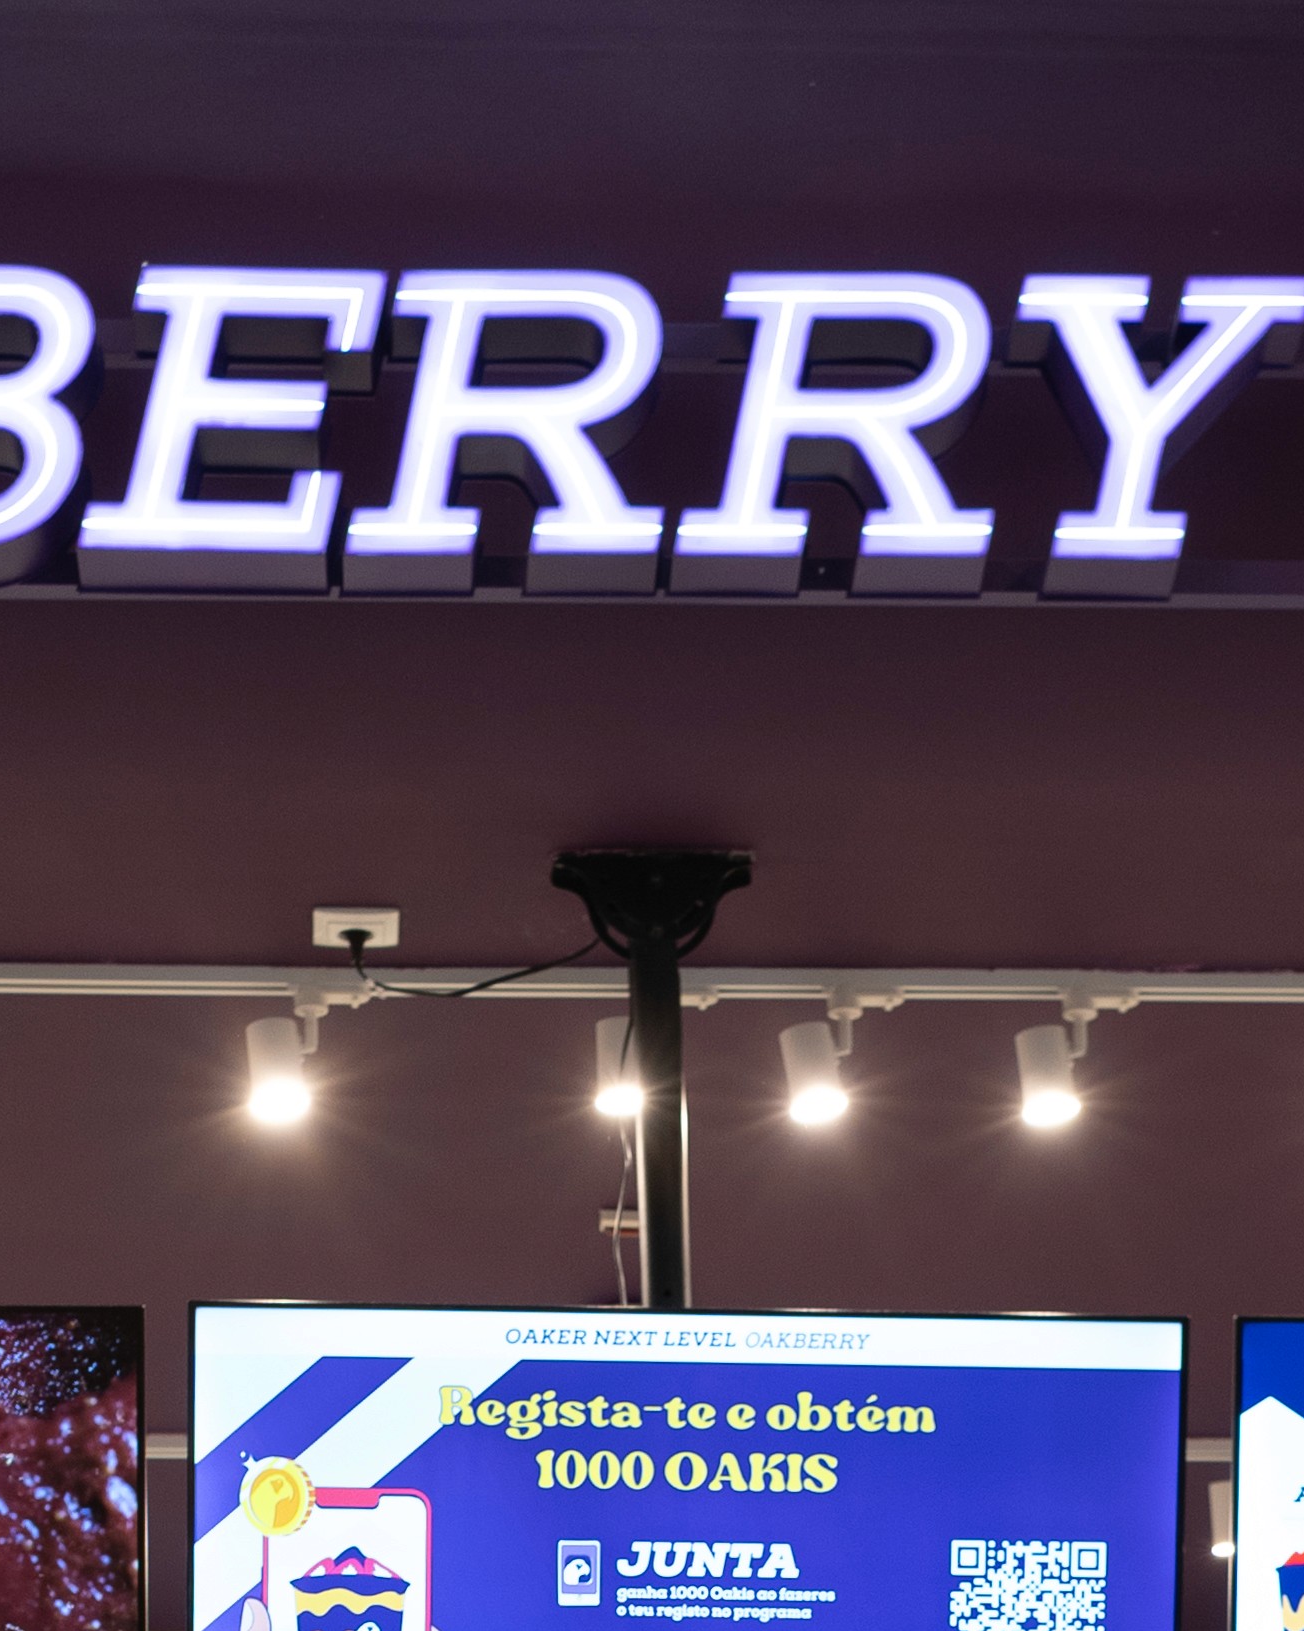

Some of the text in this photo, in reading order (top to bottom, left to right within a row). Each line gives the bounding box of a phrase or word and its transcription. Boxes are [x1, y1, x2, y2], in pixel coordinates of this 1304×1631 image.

[506, 1328, 871, 1350] OAKER NEXT LEVEL OAKBERRY
[439, 1386, 936, 1440] Regista-te e obtém
[535, 1449, 838, 1493] 1000 OAKIS
[617, 1541, 799, 1578] JUNTA
[617, 1586, 835, 1602] ganha 1000 Oakis ao fazeres
[616, 1604, 811, 1622] o teu registo no programa
